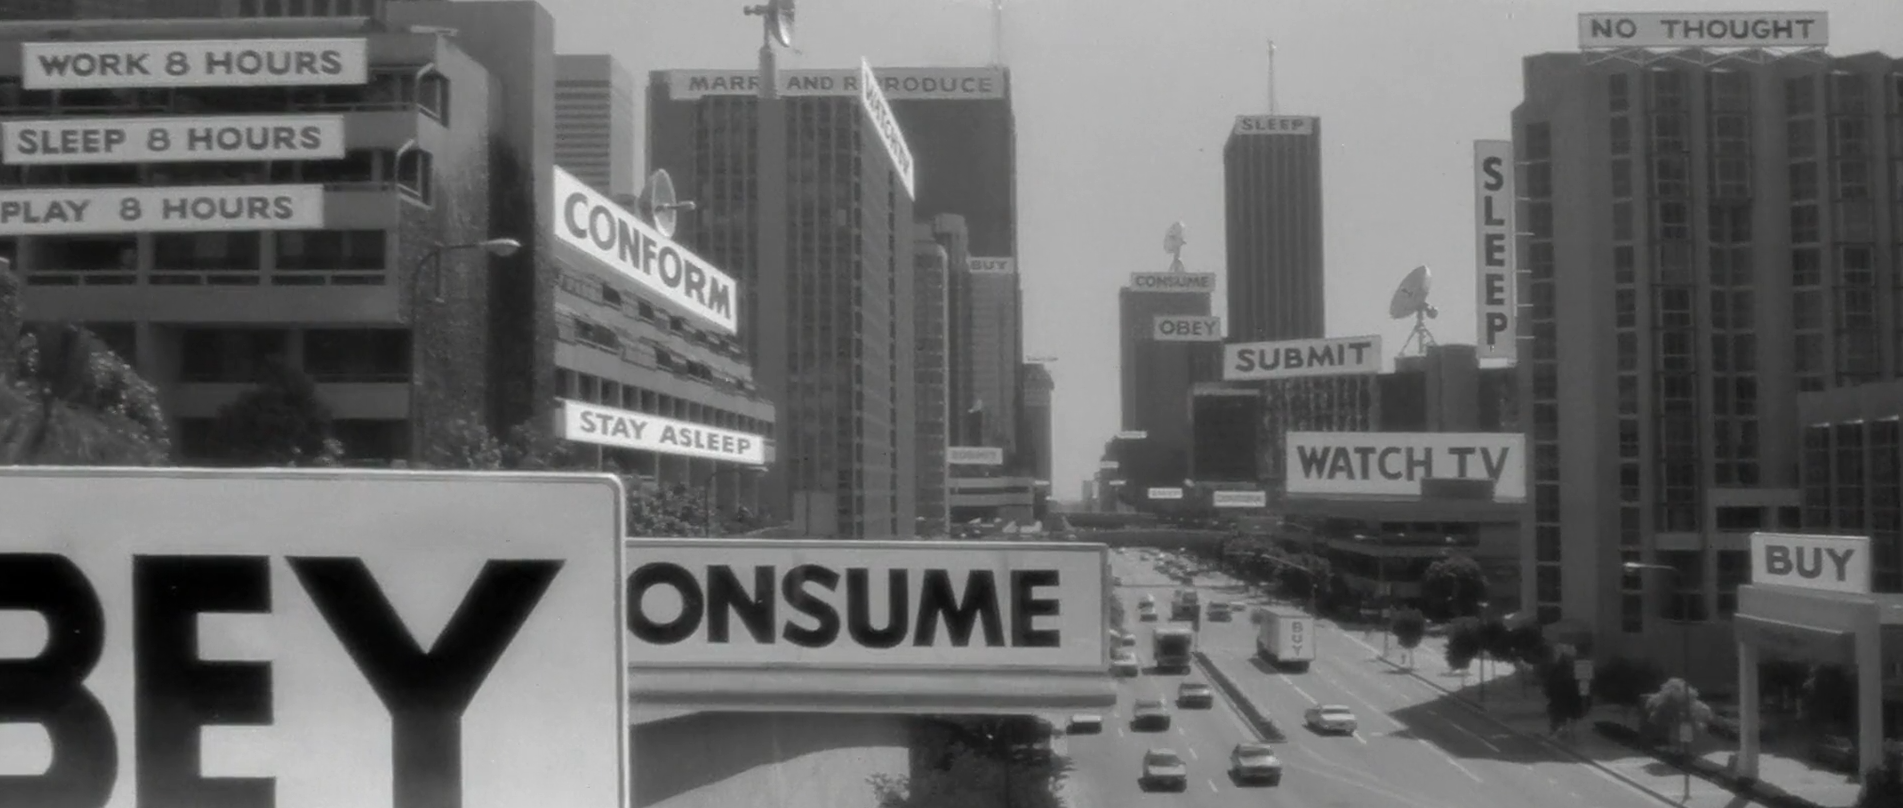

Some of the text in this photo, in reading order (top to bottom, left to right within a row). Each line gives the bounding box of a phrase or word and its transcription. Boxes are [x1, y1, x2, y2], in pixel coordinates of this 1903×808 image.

[1591, 19, 1815, 39] NO THOUGHT
[38, 49, 342, 76] WORK 8 HOURS
[689, 75, 993, 93] MARR AND RRODUCE
[17, 125, 322, 156] SLEEP 8 HOURS
[1241, 119, 1304, 131] SLEEP
[1, 195, 293, 224] PLAY 8 HOURS
[564, 192, 731, 320] CONFORM
[970, 259, 1008, 271] BUY
[1482, 156, 1508, 346] SLEEP
[1135, 275, 1210, 288] CONSUME
[1158, 319, 1217, 336] OBEY
[1235, 342, 1372, 373] SUBMIT
[579, 410, 752, 455] STAY ASLEEP
[1297, 445, 1511, 482] WATCH TV
[1765, 544, 1856, 582] BUY
[626, 561, 1061, 648] ONSUME
[1291, 621, 1303, 657] BUY
[0, 553, 567, 808] BEY
